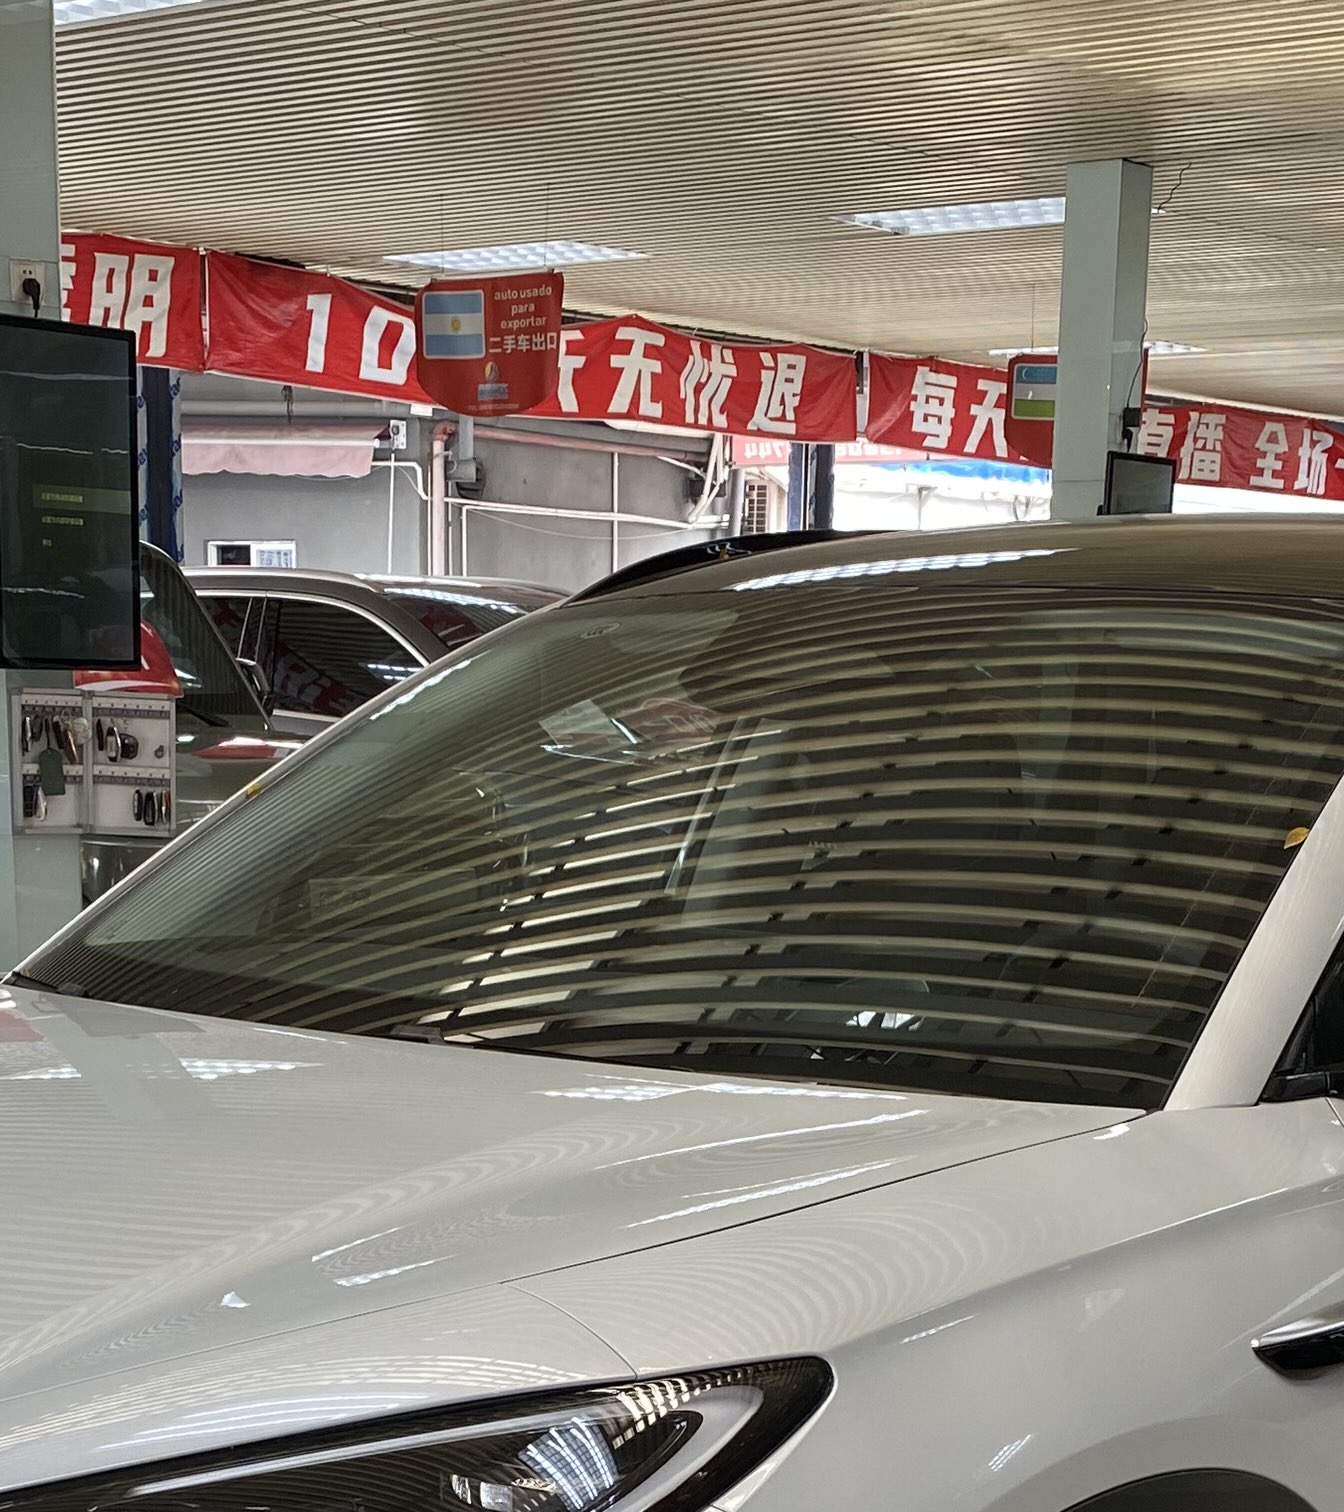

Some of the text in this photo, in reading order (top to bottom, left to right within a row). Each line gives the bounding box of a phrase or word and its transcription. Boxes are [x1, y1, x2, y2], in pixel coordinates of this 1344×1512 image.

[494, 285, 552, 301] auto usado
[511, 302, 535, 316] para
[500, 315, 548, 331] exportar
[488, 331, 557, 354] 二手车出口
